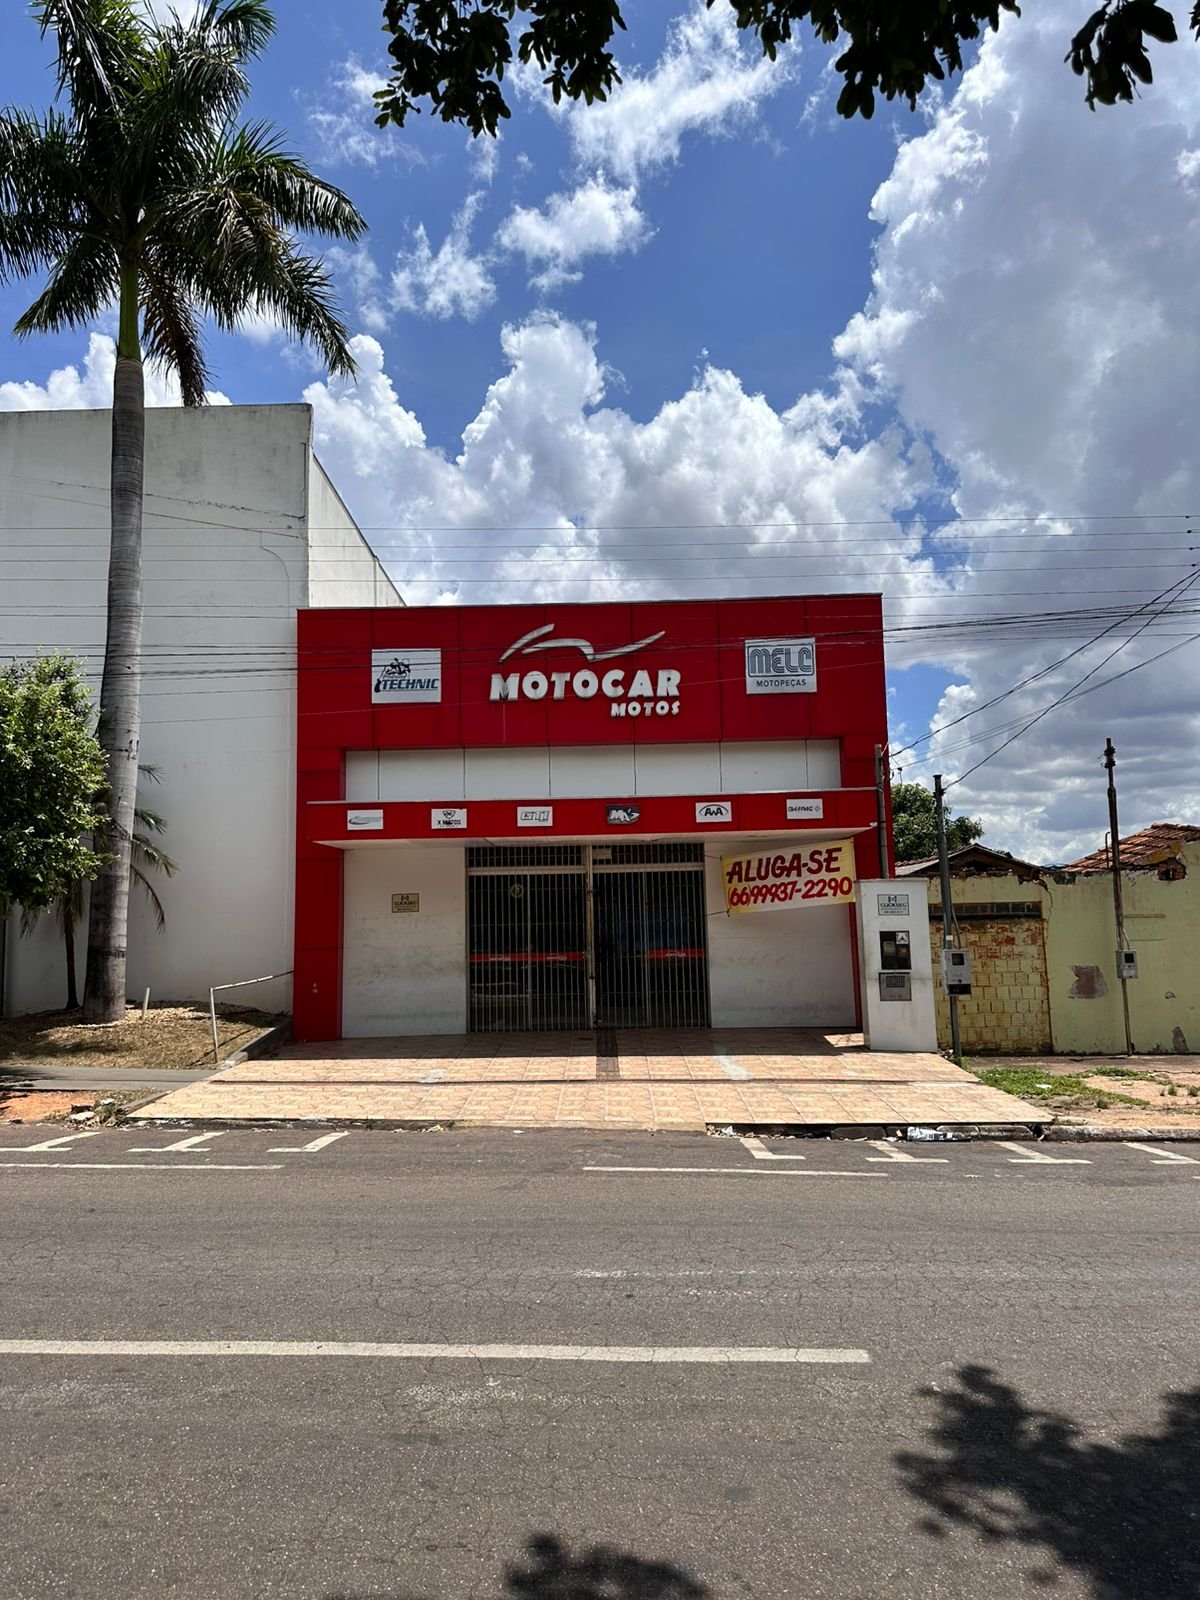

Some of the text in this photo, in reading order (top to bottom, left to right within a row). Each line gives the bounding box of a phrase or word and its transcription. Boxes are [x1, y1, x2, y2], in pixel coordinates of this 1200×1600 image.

[489, 669, 682, 701] MOTOCAR
[756, 679, 807, 688] MOTOPEÇAS
[611, 701, 681, 717] MOTOS
[726, 847, 842, 884] ALUGA-SE
[728, 876, 853, 909] (66)99937-2290
